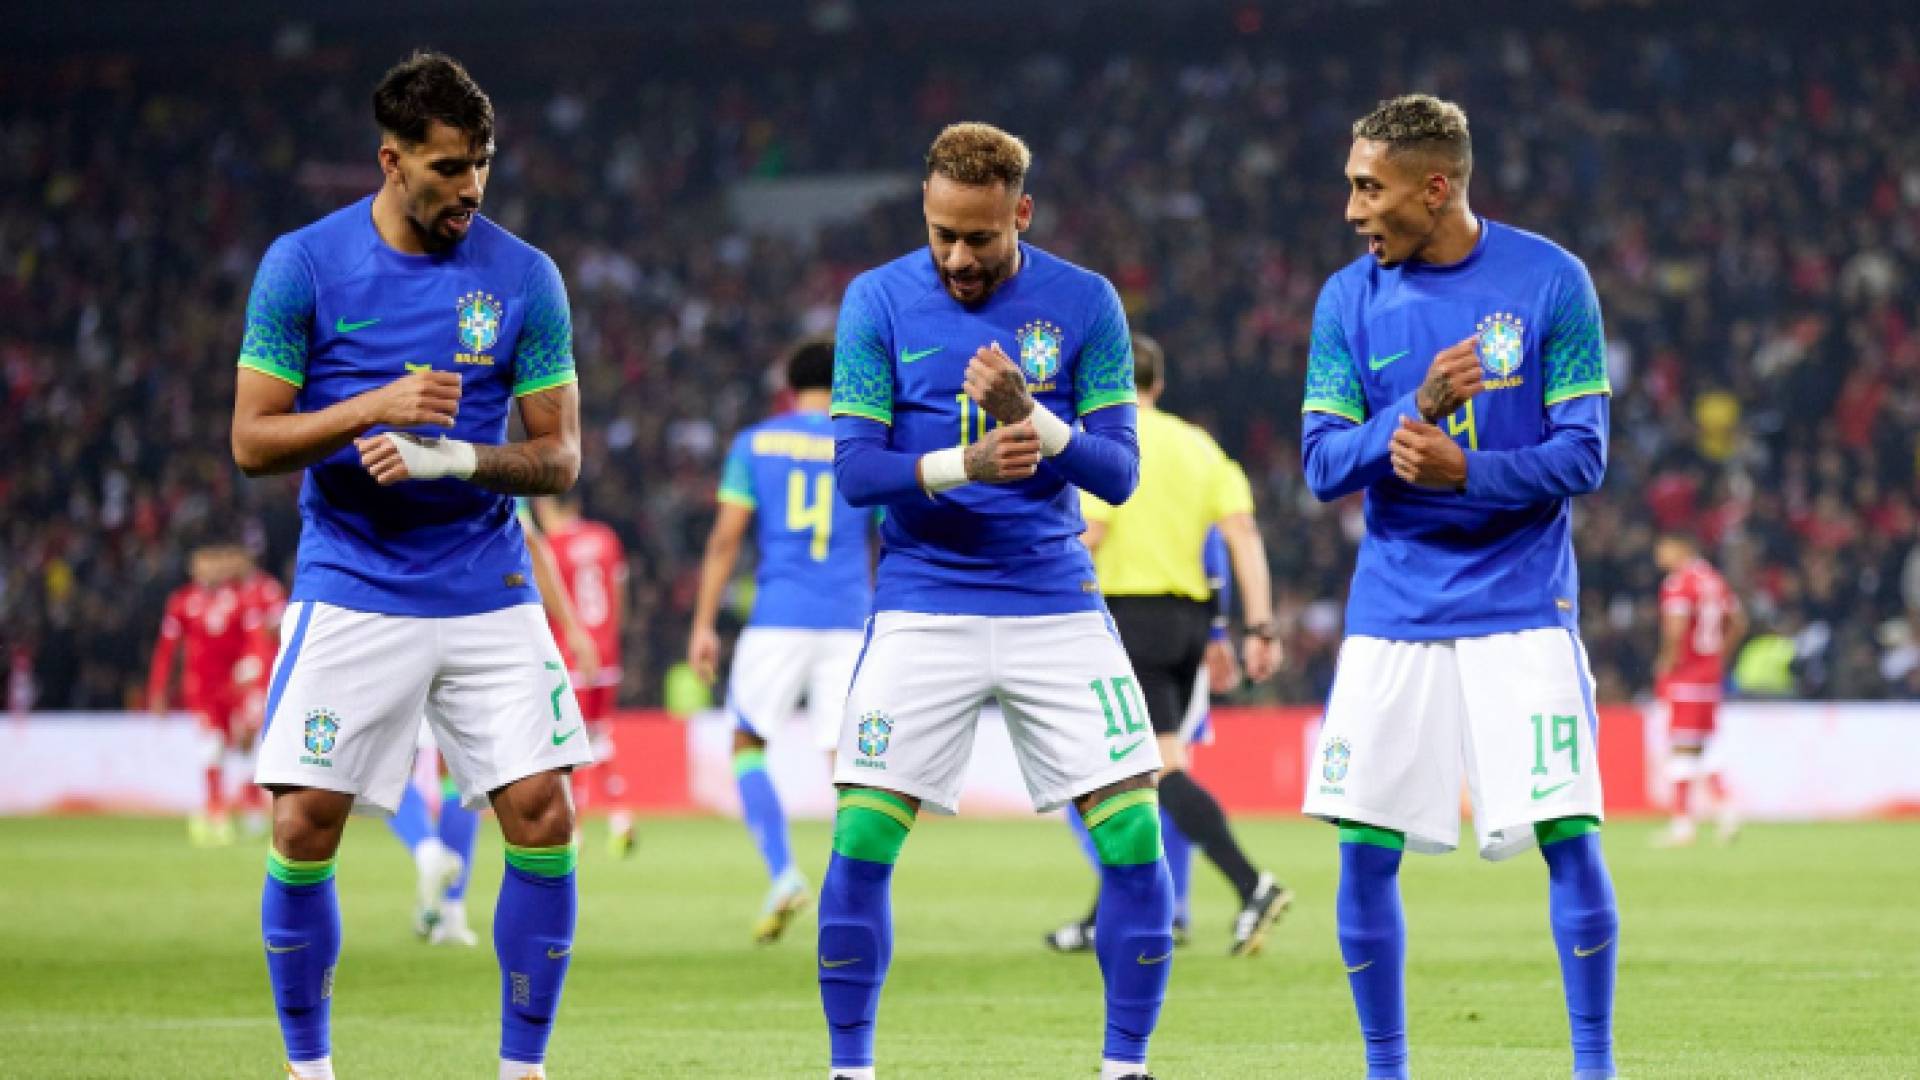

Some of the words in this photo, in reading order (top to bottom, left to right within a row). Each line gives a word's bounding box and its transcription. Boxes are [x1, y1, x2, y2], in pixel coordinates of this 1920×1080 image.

[786, 470, 833, 562] 4
[544, 661, 568, 721] 7
[1089, 675, 1147, 737] 10
[1530, 713, 1580, 775] 19
